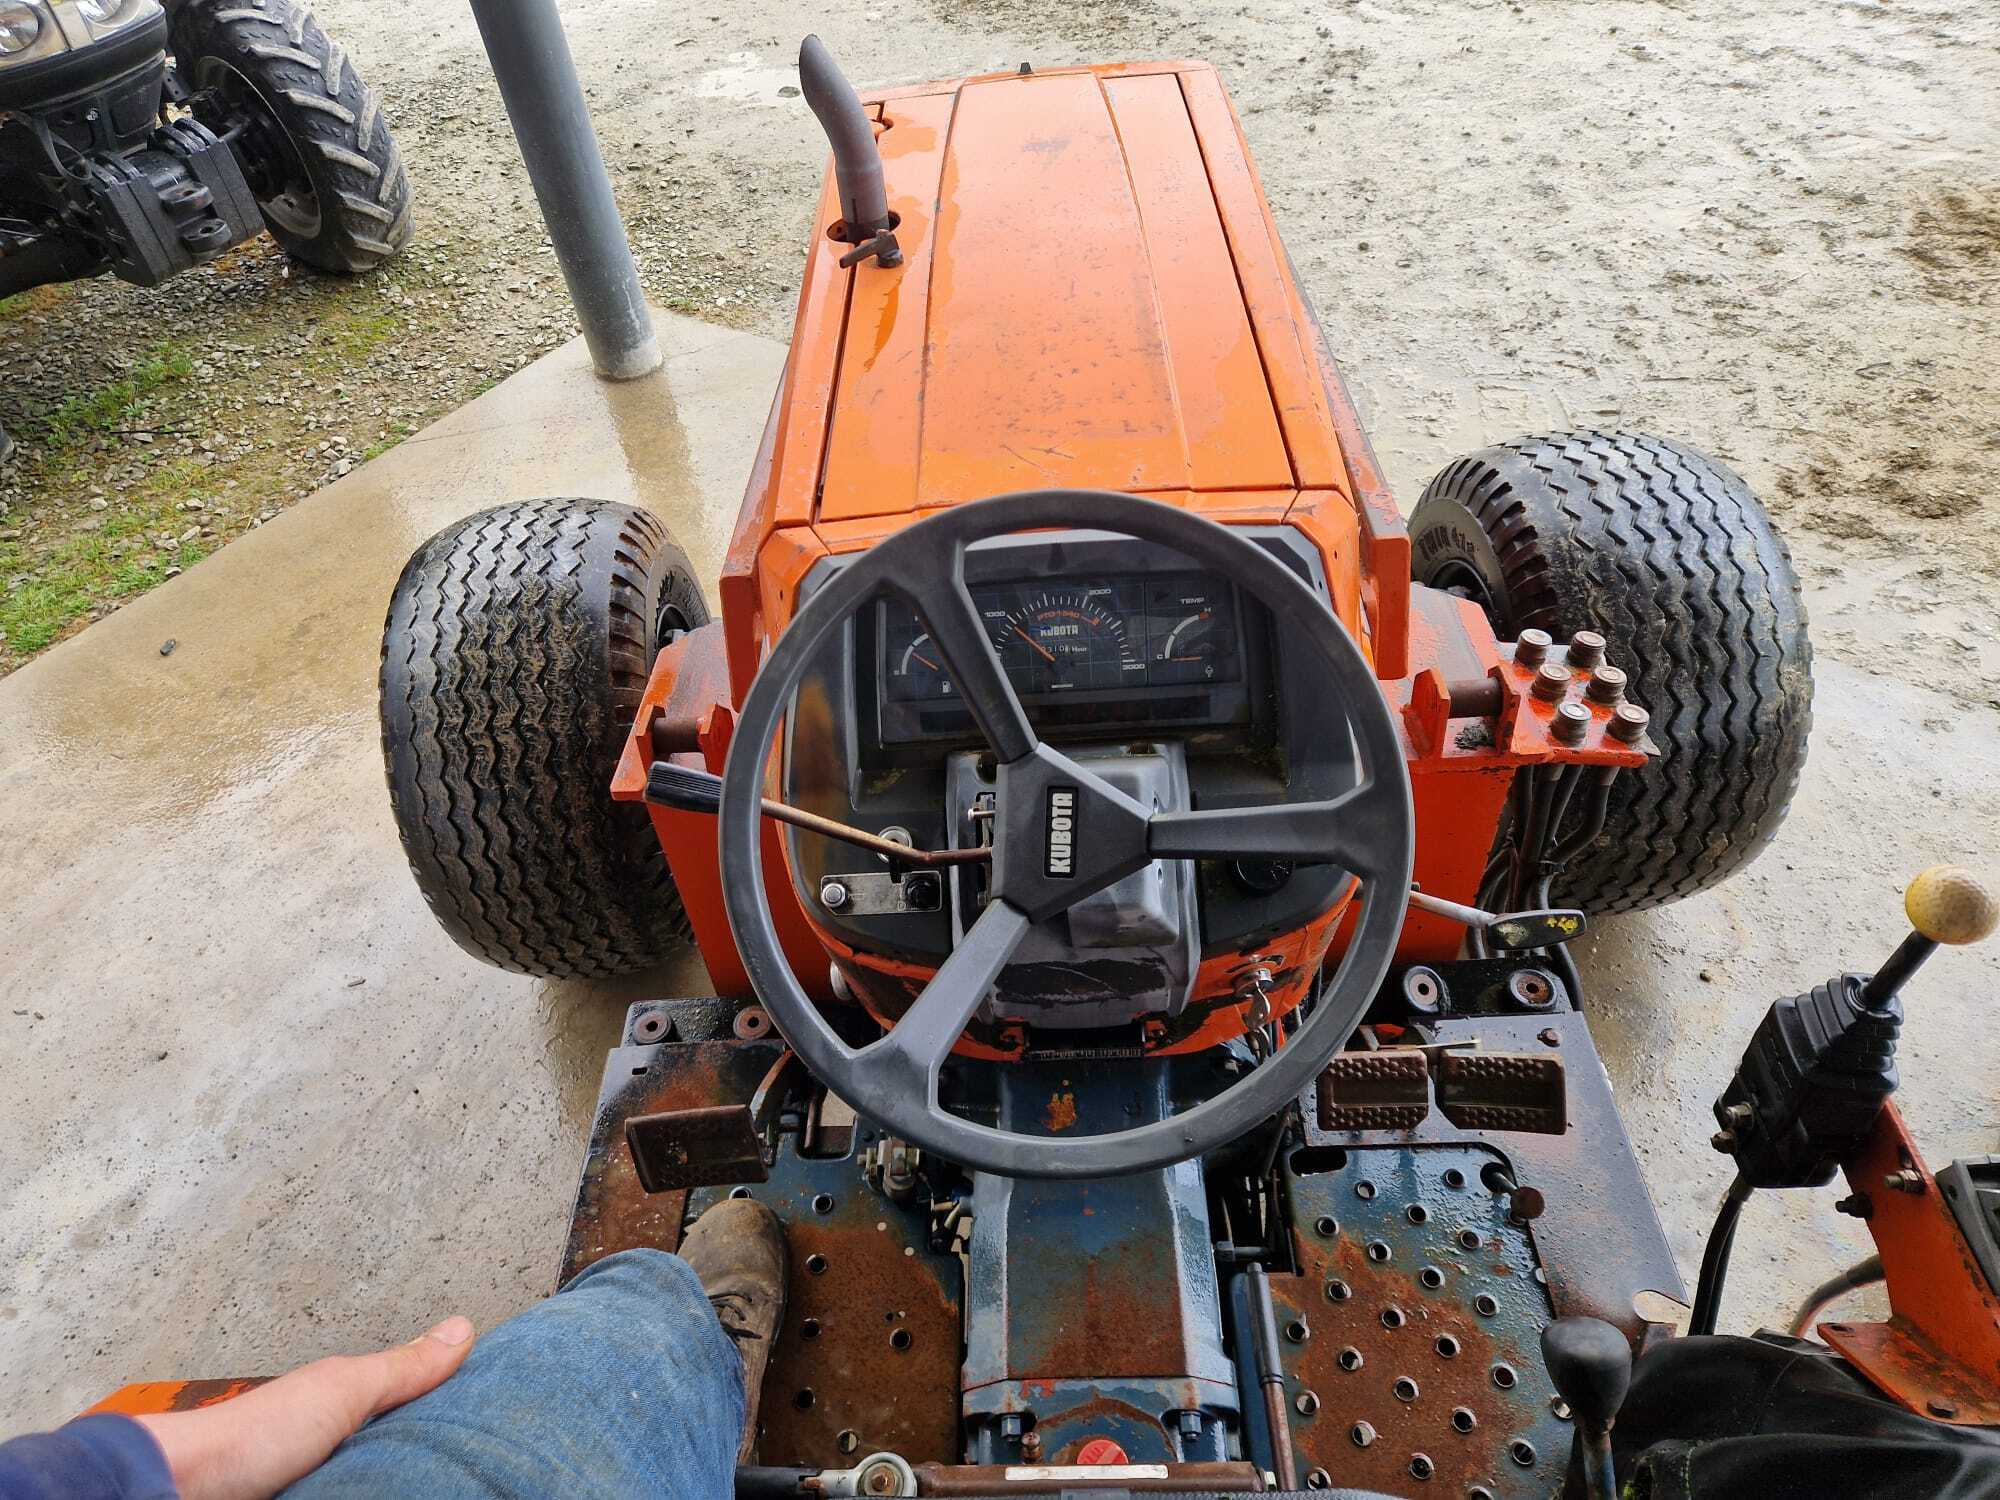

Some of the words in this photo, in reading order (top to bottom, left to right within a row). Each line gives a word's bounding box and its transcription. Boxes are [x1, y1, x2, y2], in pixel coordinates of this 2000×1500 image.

[1180, 596, 1205, 605] TEMP
[984, 610, 1006, 618] 1000
[1040, 624, 1079, 637] KUBOTA
[1121, 663, 1146, 671] 3000
[1049, 792, 1073, 873] KUBOTA
